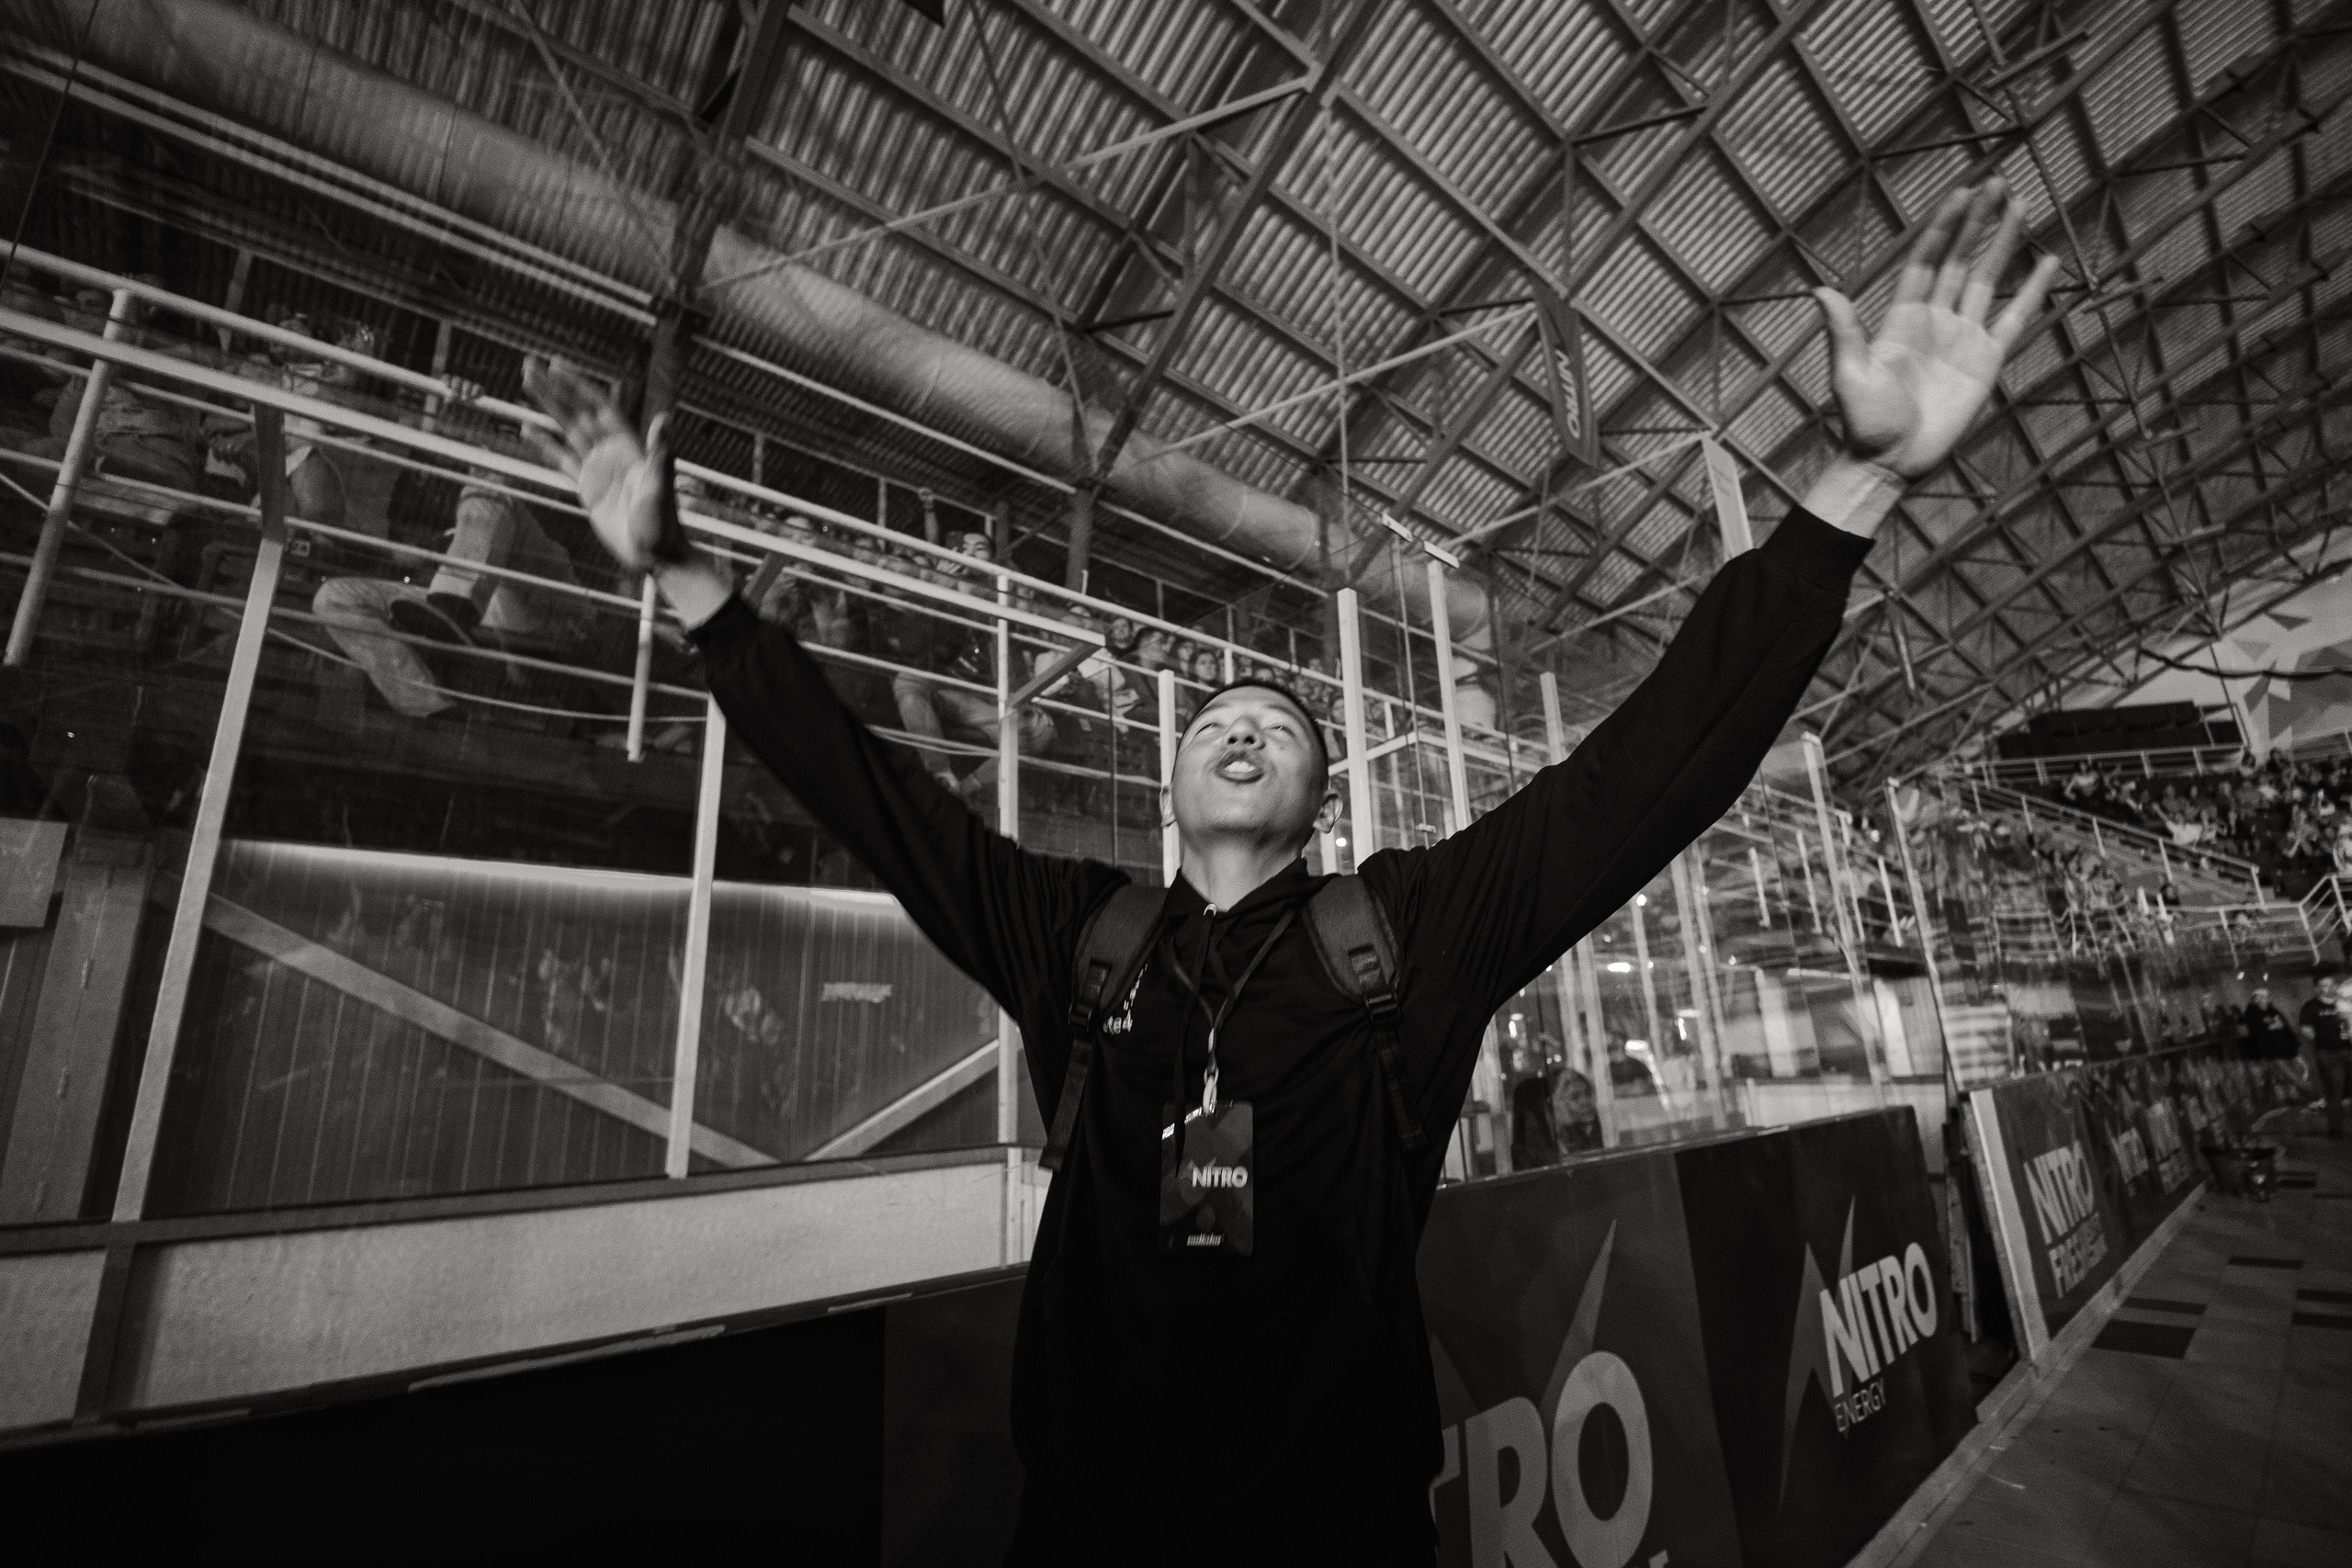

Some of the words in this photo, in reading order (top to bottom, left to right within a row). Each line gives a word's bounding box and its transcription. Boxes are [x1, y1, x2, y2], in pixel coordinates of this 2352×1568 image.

[1192, 1165, 1249, 1188] NITRO
[2023, 1139, 2095, 1246] NITRO
[1819, 1242, 1938, 1398] NITRO
[1835, 1379, 1886, 1433] ENERGY
